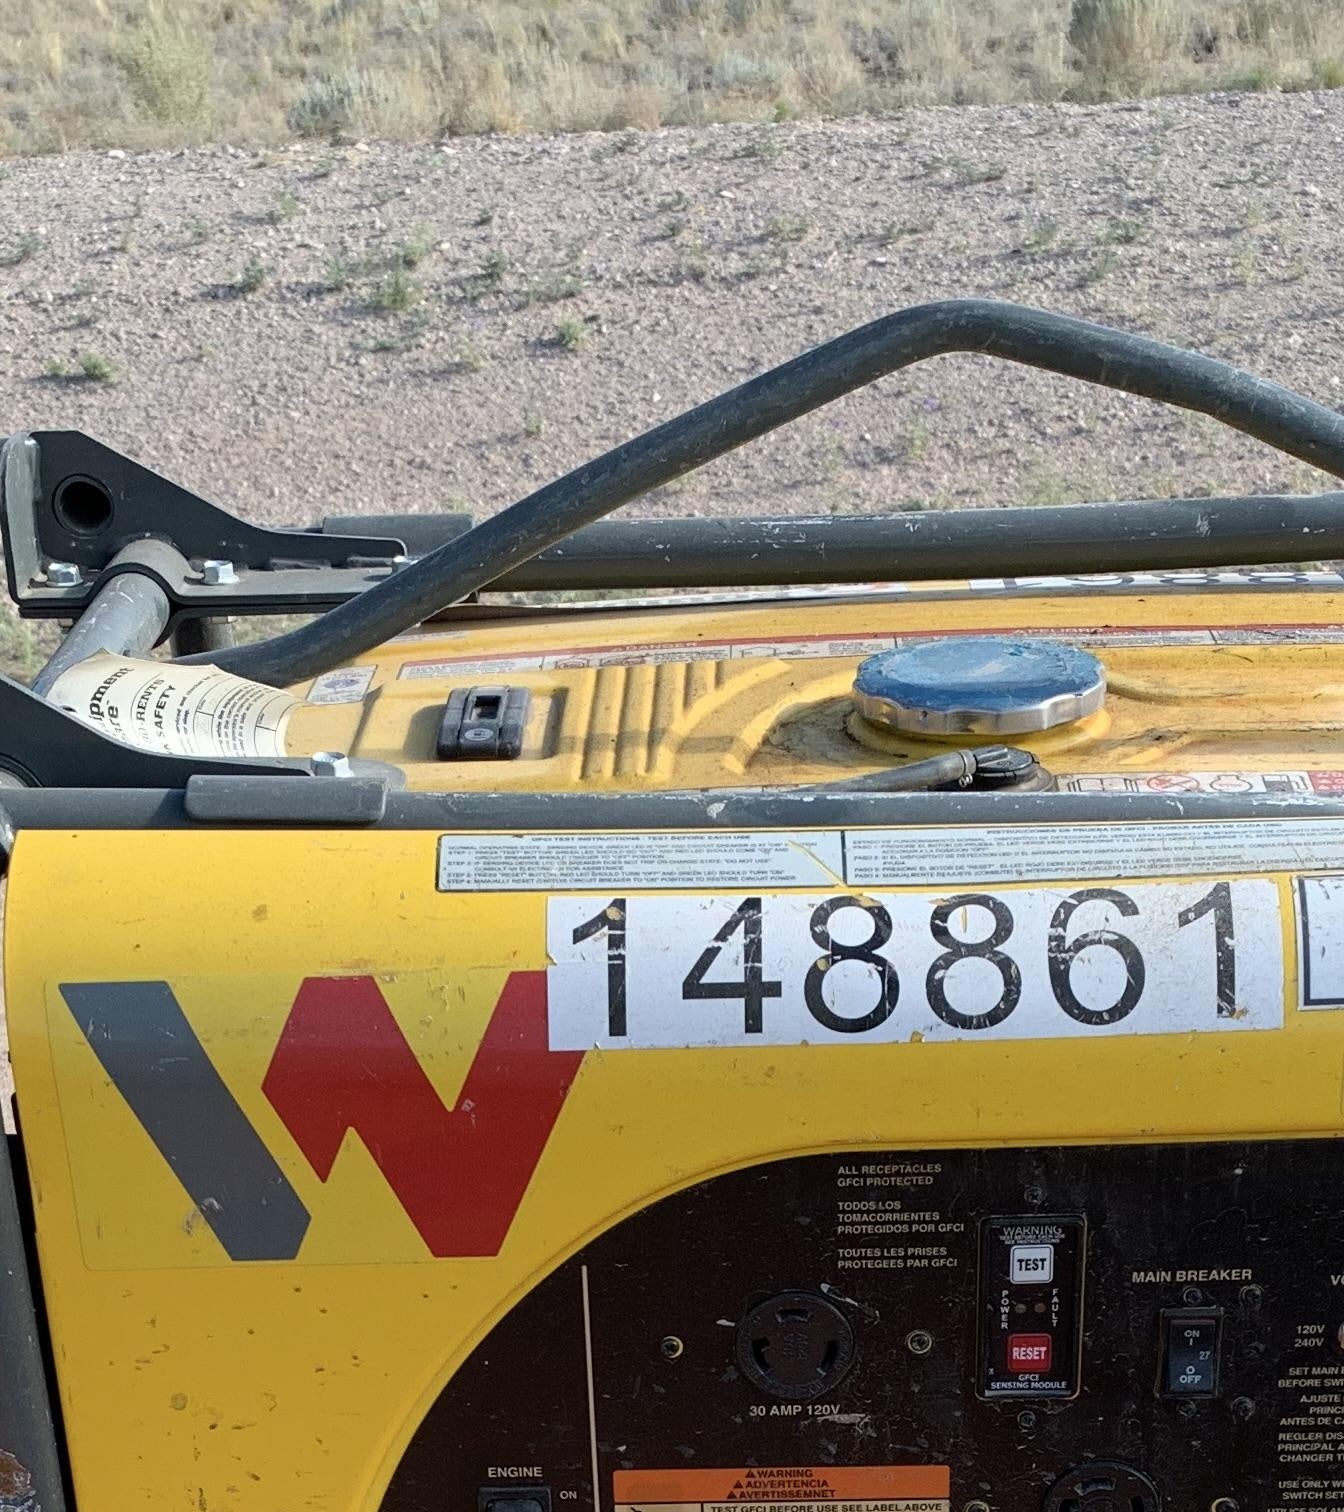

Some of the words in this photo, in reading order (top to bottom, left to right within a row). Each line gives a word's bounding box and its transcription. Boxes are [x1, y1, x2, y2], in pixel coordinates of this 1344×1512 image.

[572, 881, 1240, 1038] 148861
[838, 1166, 859, 1174] ALL
[862, 1164, 942, 1174] RECEPTACLES
[838, 1178, 864, 1187] GFCI
[866, 1176, 933, 1186] PROTECTED
[838, 1201, 876, 1210] TODOS
[878, 1201, 901, 1210] LOS
[838, 1212, 940, 1222] TOMACORRIENTES
[838, 1224, 909, 1234] PROTEGIDOS
[912, 1224, 935, 1232] POR
[938, 1223, 964, 1232] GFCI
[1003, 1225, 1062, 1235] WARNING
[838, 1248, 881, 1258] TOUTES
[884, 1248, 904, 1256] LES
[908, 1247, 947, 1256] PRISES
[906, 1259, 928, 1268] PAR
[931, 1258, 958, 1267] GFCI
[1017, 1258, 1047, 1271] TEST
[1132, 1271, 1171, 1283] MAIN
[1176, 1269, 1252, 1281] BREAKER
[1000, 1290, 1009, 1329] POWER
[1184, 1330, 1200, 1338] ON
[1297, 1325, 1325, 1334] 120V
[1295, 1338, 1324, 1347] 240V
[1013, 1347, 1047, 1360] RESET
[1312, 1367, 1338, 1375] MAIN
[1278, 1379, 1322, 1388] BEFORE
[1300, 1394, 1341, 1403] AJUSTE
[749, 1406, 766, 1416] 30
[770, 1405, 802, 1416] AMP
[807, 1404, 840, 1415] 120V
[1280, 1418, 1315, 1426] ANTES
[1279, 1433, 1323, 1441] REGLER
[1278, 1443, 1337, 1451] PRINCIPAL
[1280, 1454, 1333, 1462] CHANGER
[488, 1467, 543, 1478] ENGINE
[757, 1469, 813, 1478] WARNING
[745, 1479, 829, 1489] ADVERTENCIA
[1302, 1480, 1328, 1488] ONLY
[560, 1491, 577, 1499] ON
[1283, 1492, 1323, 1500] SWITCH
[1325, 1491, 1344, 1500] SET
[769, 1505, 813, 1512] BEFORE
[817, 1505, 840, 1512] USE
[866, 1504, 901, 1512] LABEL
[904, 1503, 942, 1511] ABOVE
